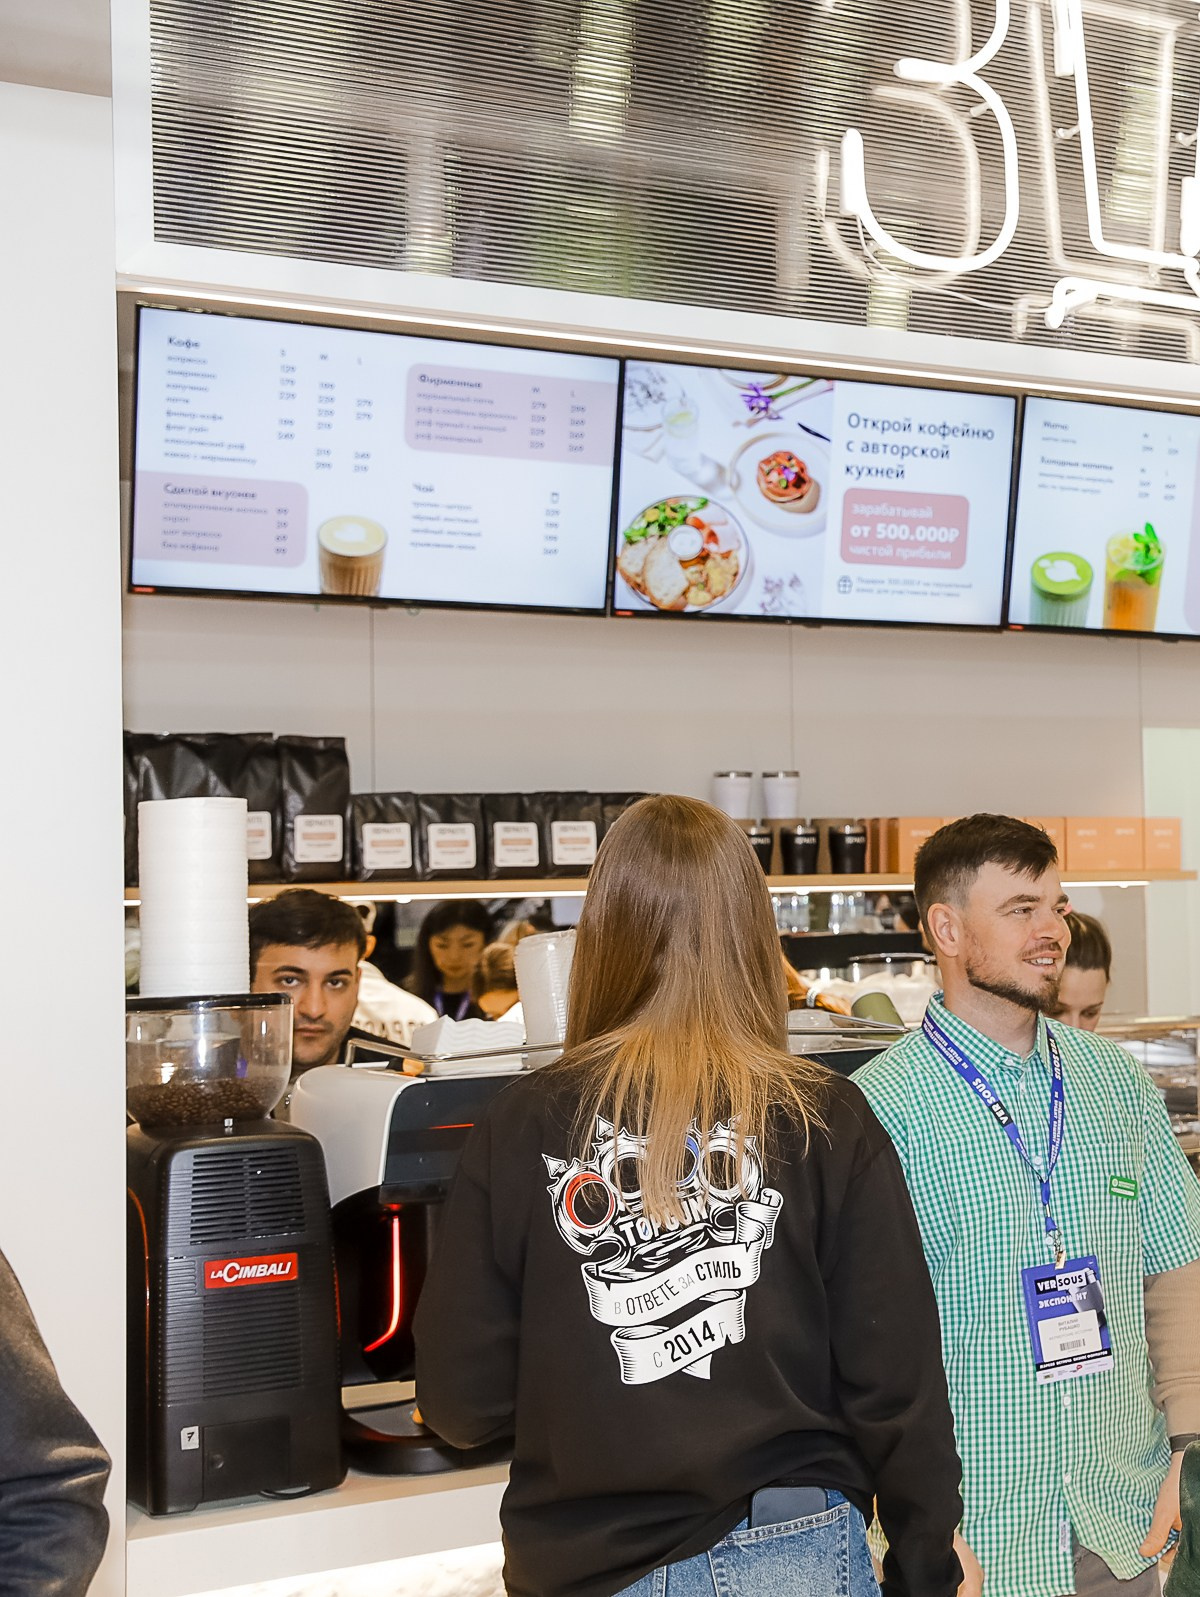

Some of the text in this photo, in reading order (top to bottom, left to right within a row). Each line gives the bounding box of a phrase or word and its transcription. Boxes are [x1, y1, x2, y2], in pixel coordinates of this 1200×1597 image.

[168, 337, 200, 349] Кофе
[419, 373, 482, 388] Фирменные
[847, 412, 995, 440] Открой кофейню
[846, 441, 950, 460] с авторской
[845, 462, 905, 480] кухней
[412, 482, 435, 493] Чай
[852, 502, 933, 520] зарабатывай
[850, 525, 871, 538] от
[849, 545, 952, 562] чистой прибыли
[613, 1260, 742, 1316] В ОТВЕТЕ ЗА СТИЛЬ
[1038, 1292, 1088, 1309] ЭКСПОННТ
[663, 1320, 716, 1363] 2014
